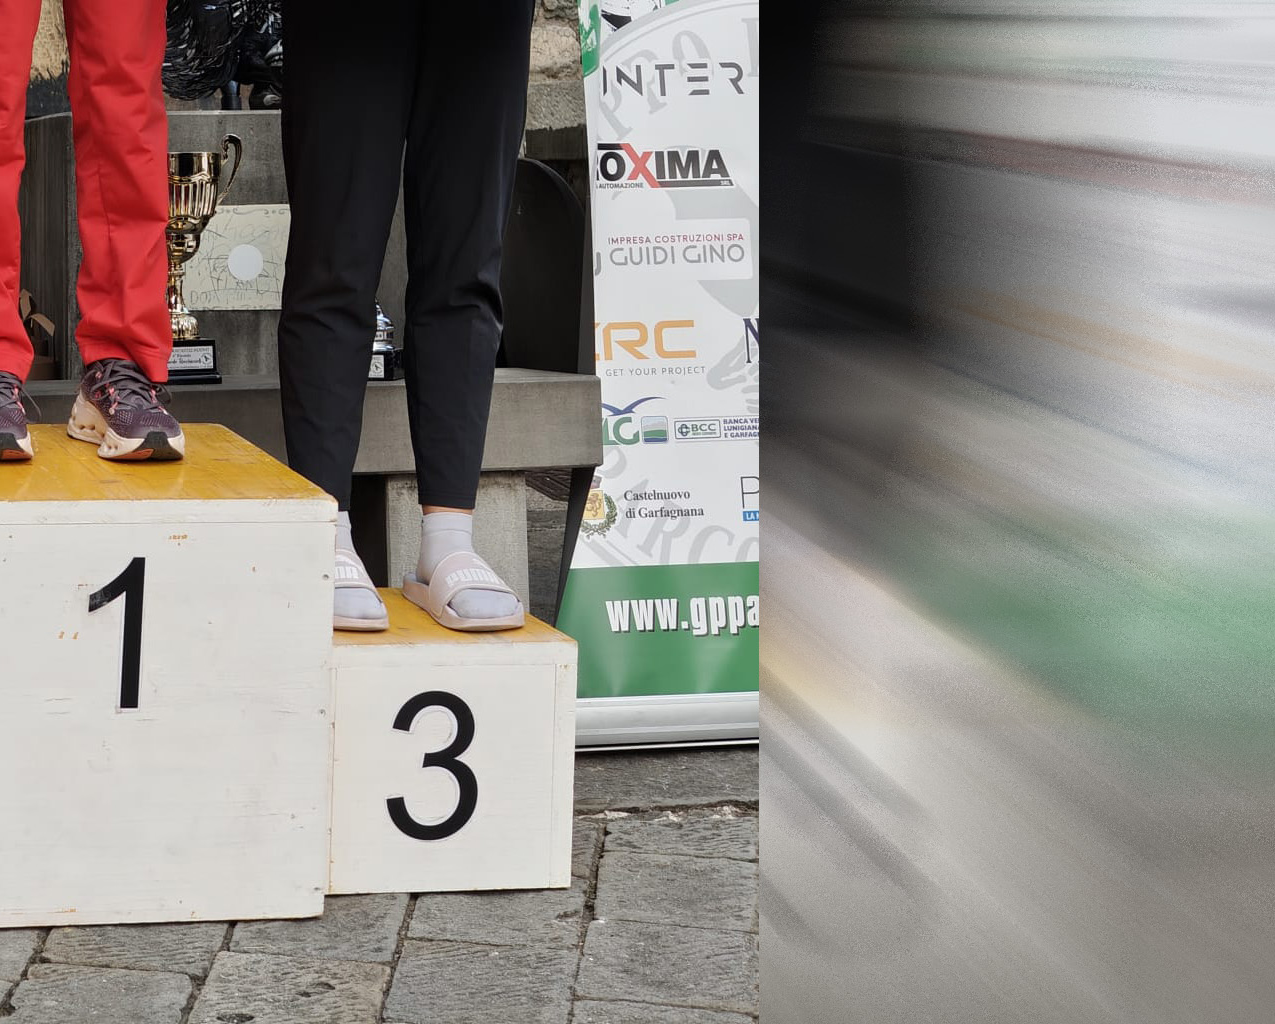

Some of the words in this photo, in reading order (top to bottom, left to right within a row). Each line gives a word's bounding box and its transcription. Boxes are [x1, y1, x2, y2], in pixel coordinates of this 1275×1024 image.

[602, 62, 745, 97] INTER
[597, 143, 732, 188] OXIMA
[608, 236, 651, 245] IMPRESA
[654, 234, 724, 244] COSTRUZIONI
[727, 233, 744, 241] SPA
[610, 246, 675, 266] GUIDI
[683, 244, 745, 264] GINO
[595, 320, 696, 361] RC
[605, 369, 624, 377] GET
[629, 368, 657, 376] YOUR
[662, 366, 706, 375] PROJECT
[691, 424, 716, 432] BCC
[624, 490, 690, 502] Castelnuovo
[625, 508, 636, 519] di
[638, 507, 705, 520] Garfagnana
[87, 557, 147, 709] 1
[386, 690, 478, 841] 3
